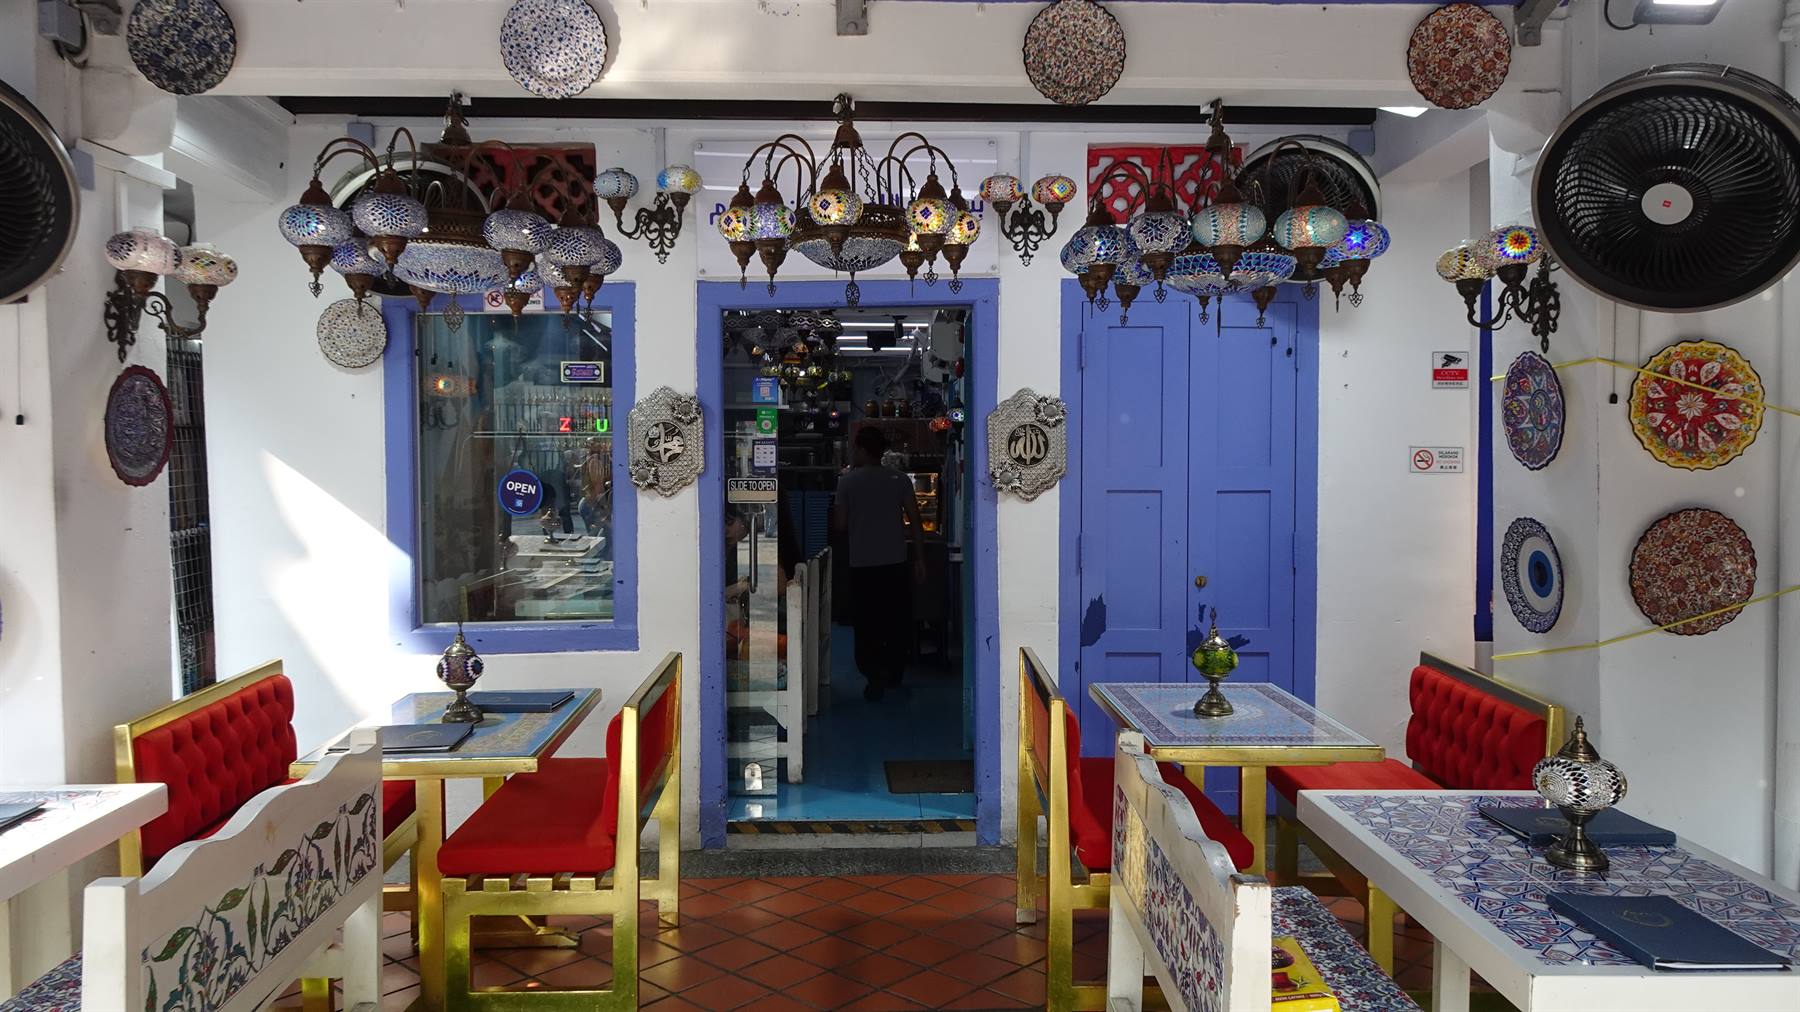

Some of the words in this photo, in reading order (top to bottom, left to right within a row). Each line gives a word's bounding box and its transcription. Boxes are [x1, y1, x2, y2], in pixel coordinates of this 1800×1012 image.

[560, 417, 571, 432] Z
[596, 418, 608, 432] U
[506, 480, 536, 495] OPEN
[730, 480, 748, 490] SLIDE
[749, 480, 757, 490] TO
[758, 480, 775, 490] OPEN
